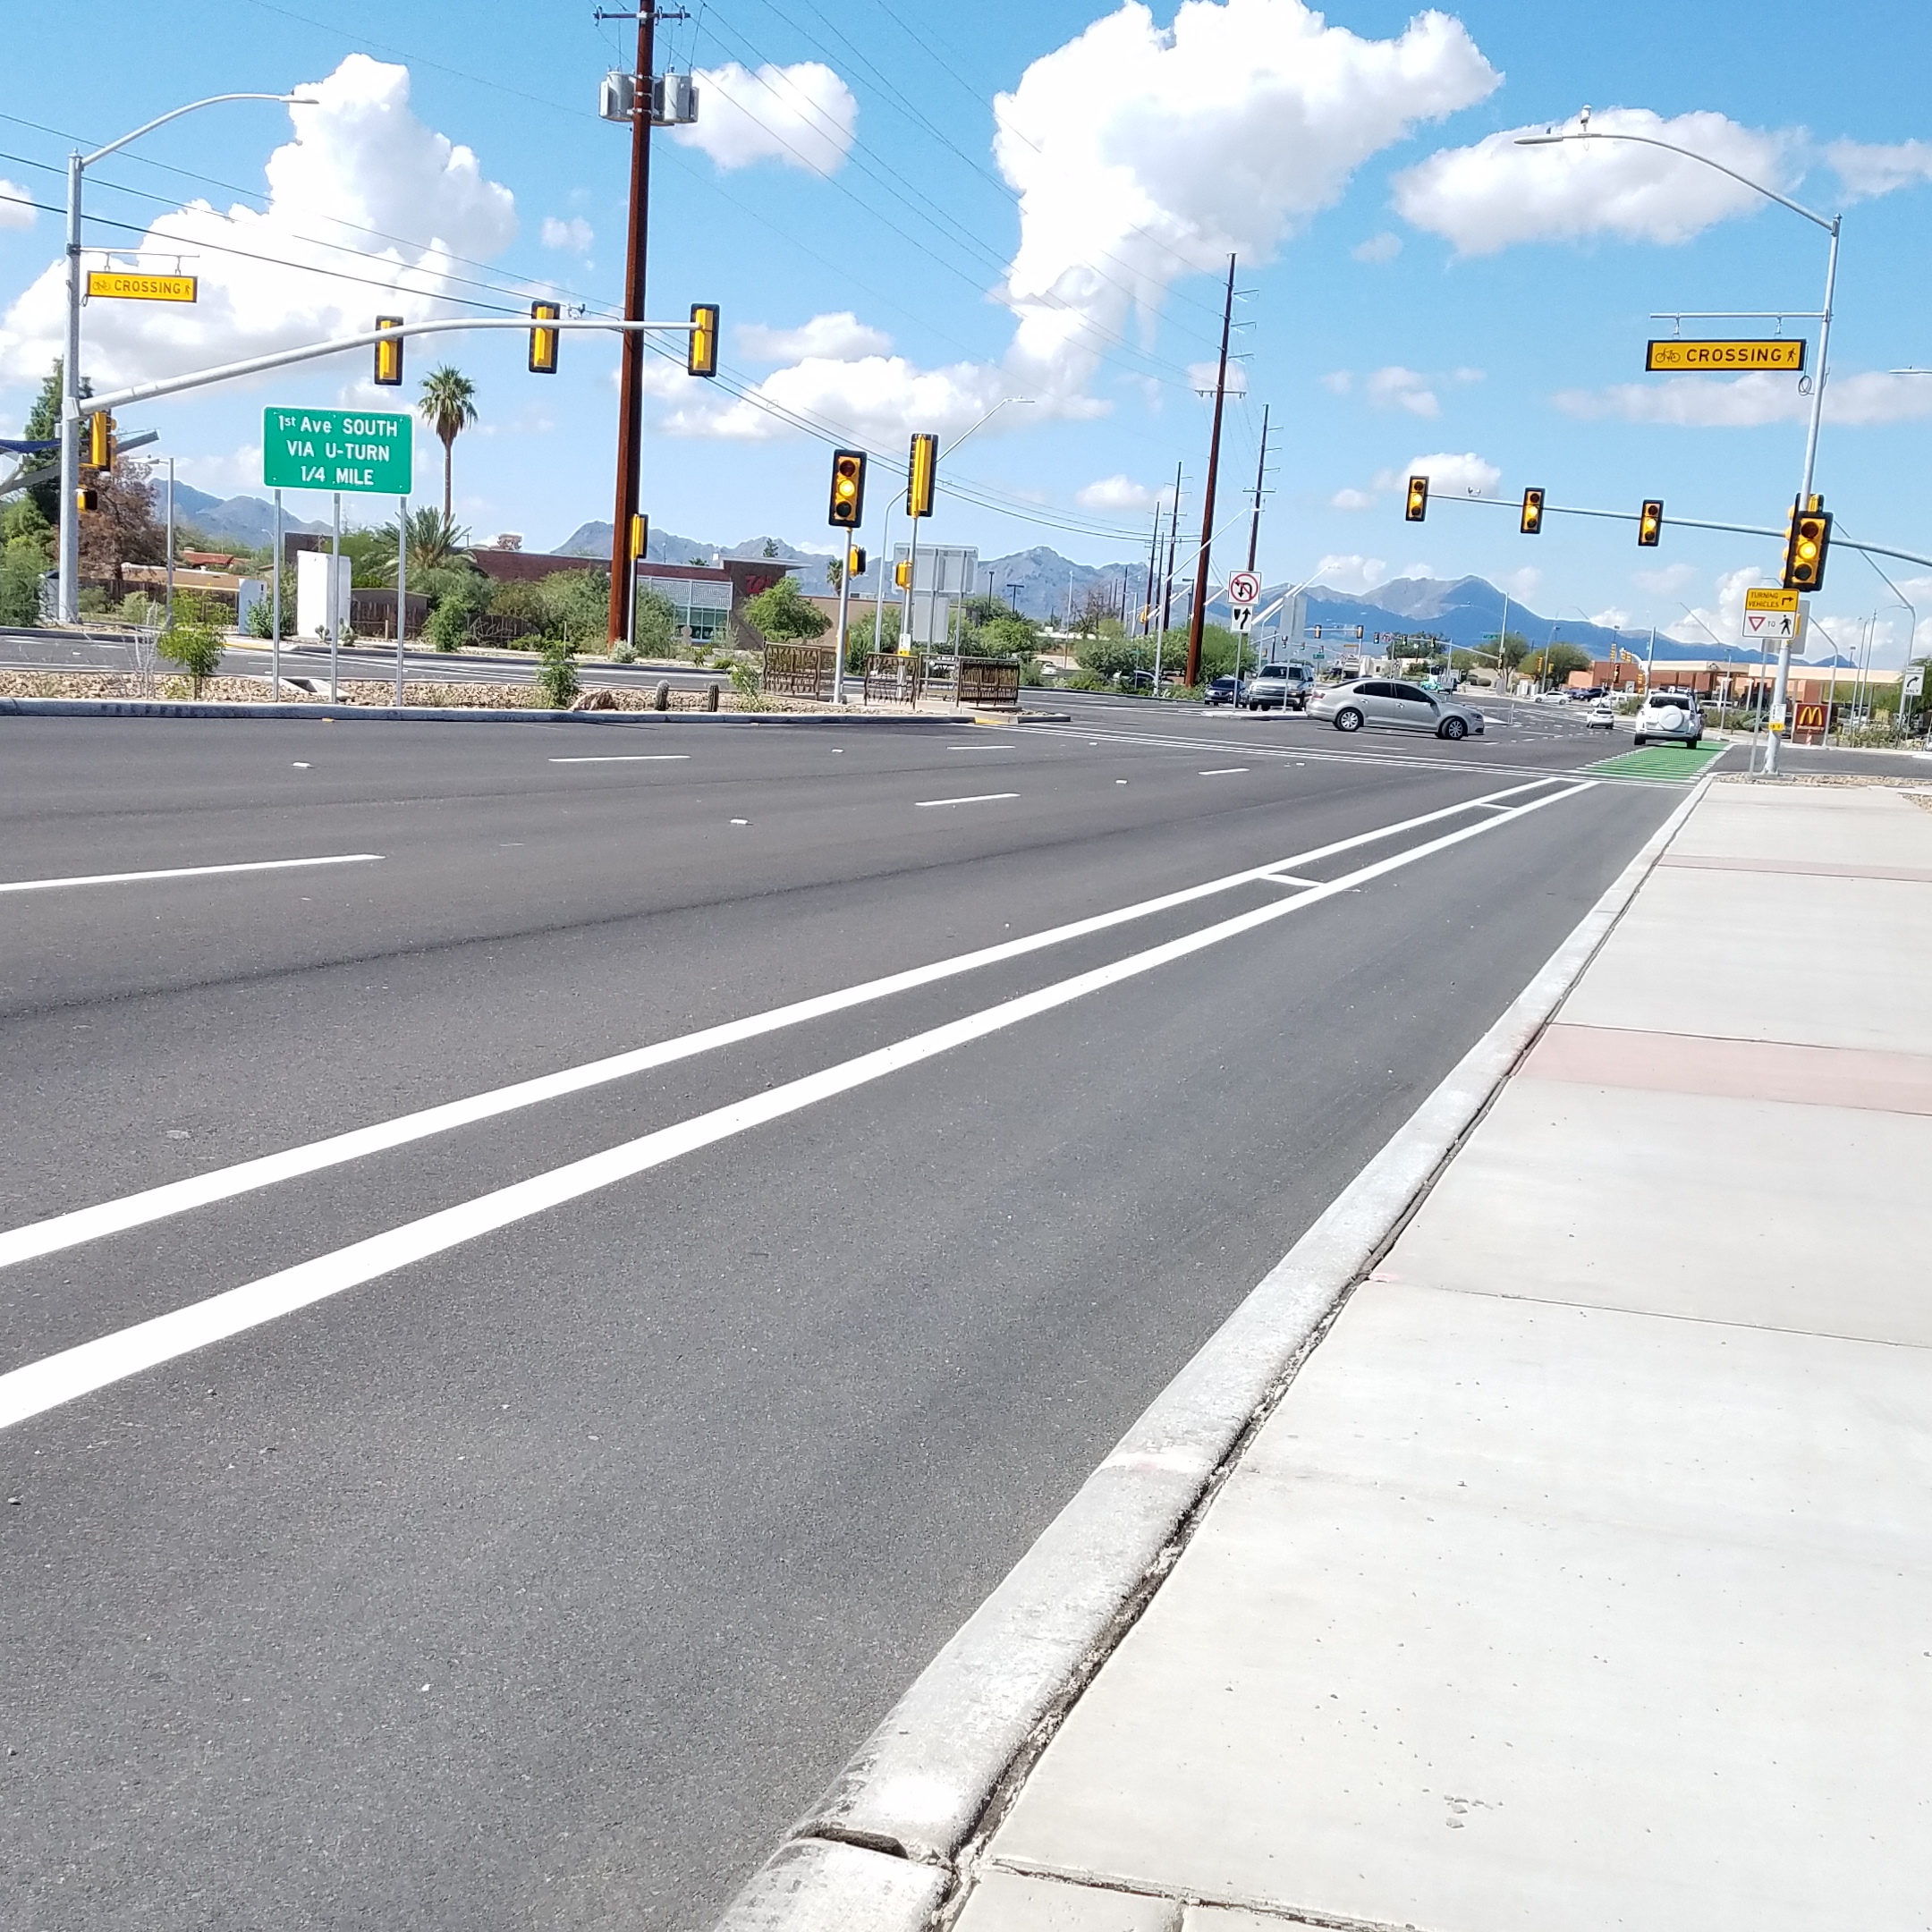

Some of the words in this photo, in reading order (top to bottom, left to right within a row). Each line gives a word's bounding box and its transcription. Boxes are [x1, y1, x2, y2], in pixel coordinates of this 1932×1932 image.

[114, 279, 182, 294] CROSSING
[1686, 347, 1783, 362] CROSSING
[278, 414, 297, 432] 1st
[300, 416, 333, 434] Ave
[343, 418, 398, 437] SOUTH
[286, 439, 315, 457] VIA
[325, 442, 390, 462] U-TURN
[301, 465, 326, 483] 1/4
[335, 467, 375, 486] MILE
[1750, 591, 1779, 599] TURNING
[1748, 600, 1779, 608] VEHICLES
